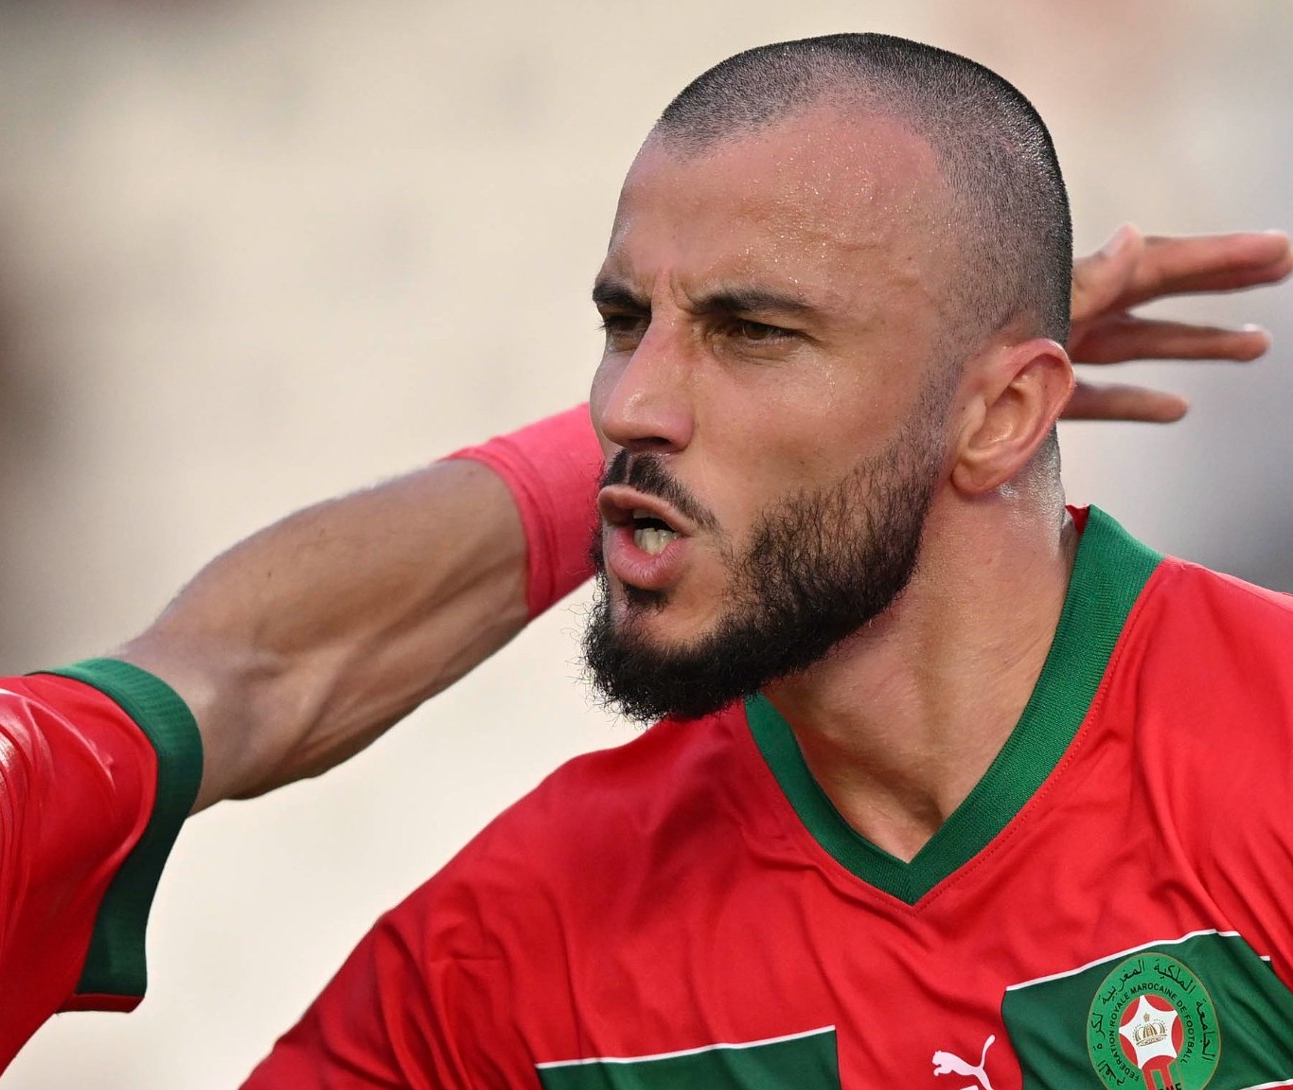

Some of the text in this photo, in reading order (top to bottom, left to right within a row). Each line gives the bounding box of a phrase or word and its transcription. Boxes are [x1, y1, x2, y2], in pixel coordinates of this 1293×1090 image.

[1098, 959, 1146, 1005] المغربية
[1130, 982, 1178, 1000] MAROCAINE
[1154, 958, 1196, 995] الملكية
[1110, 991, 1130, 1027] ROYALE
[1176, 999, 1187, 1013] DE
[1180, 1013, 1195, 1064] FOOTBALL
[1196, 998, 1216, 1062] الجامعة
